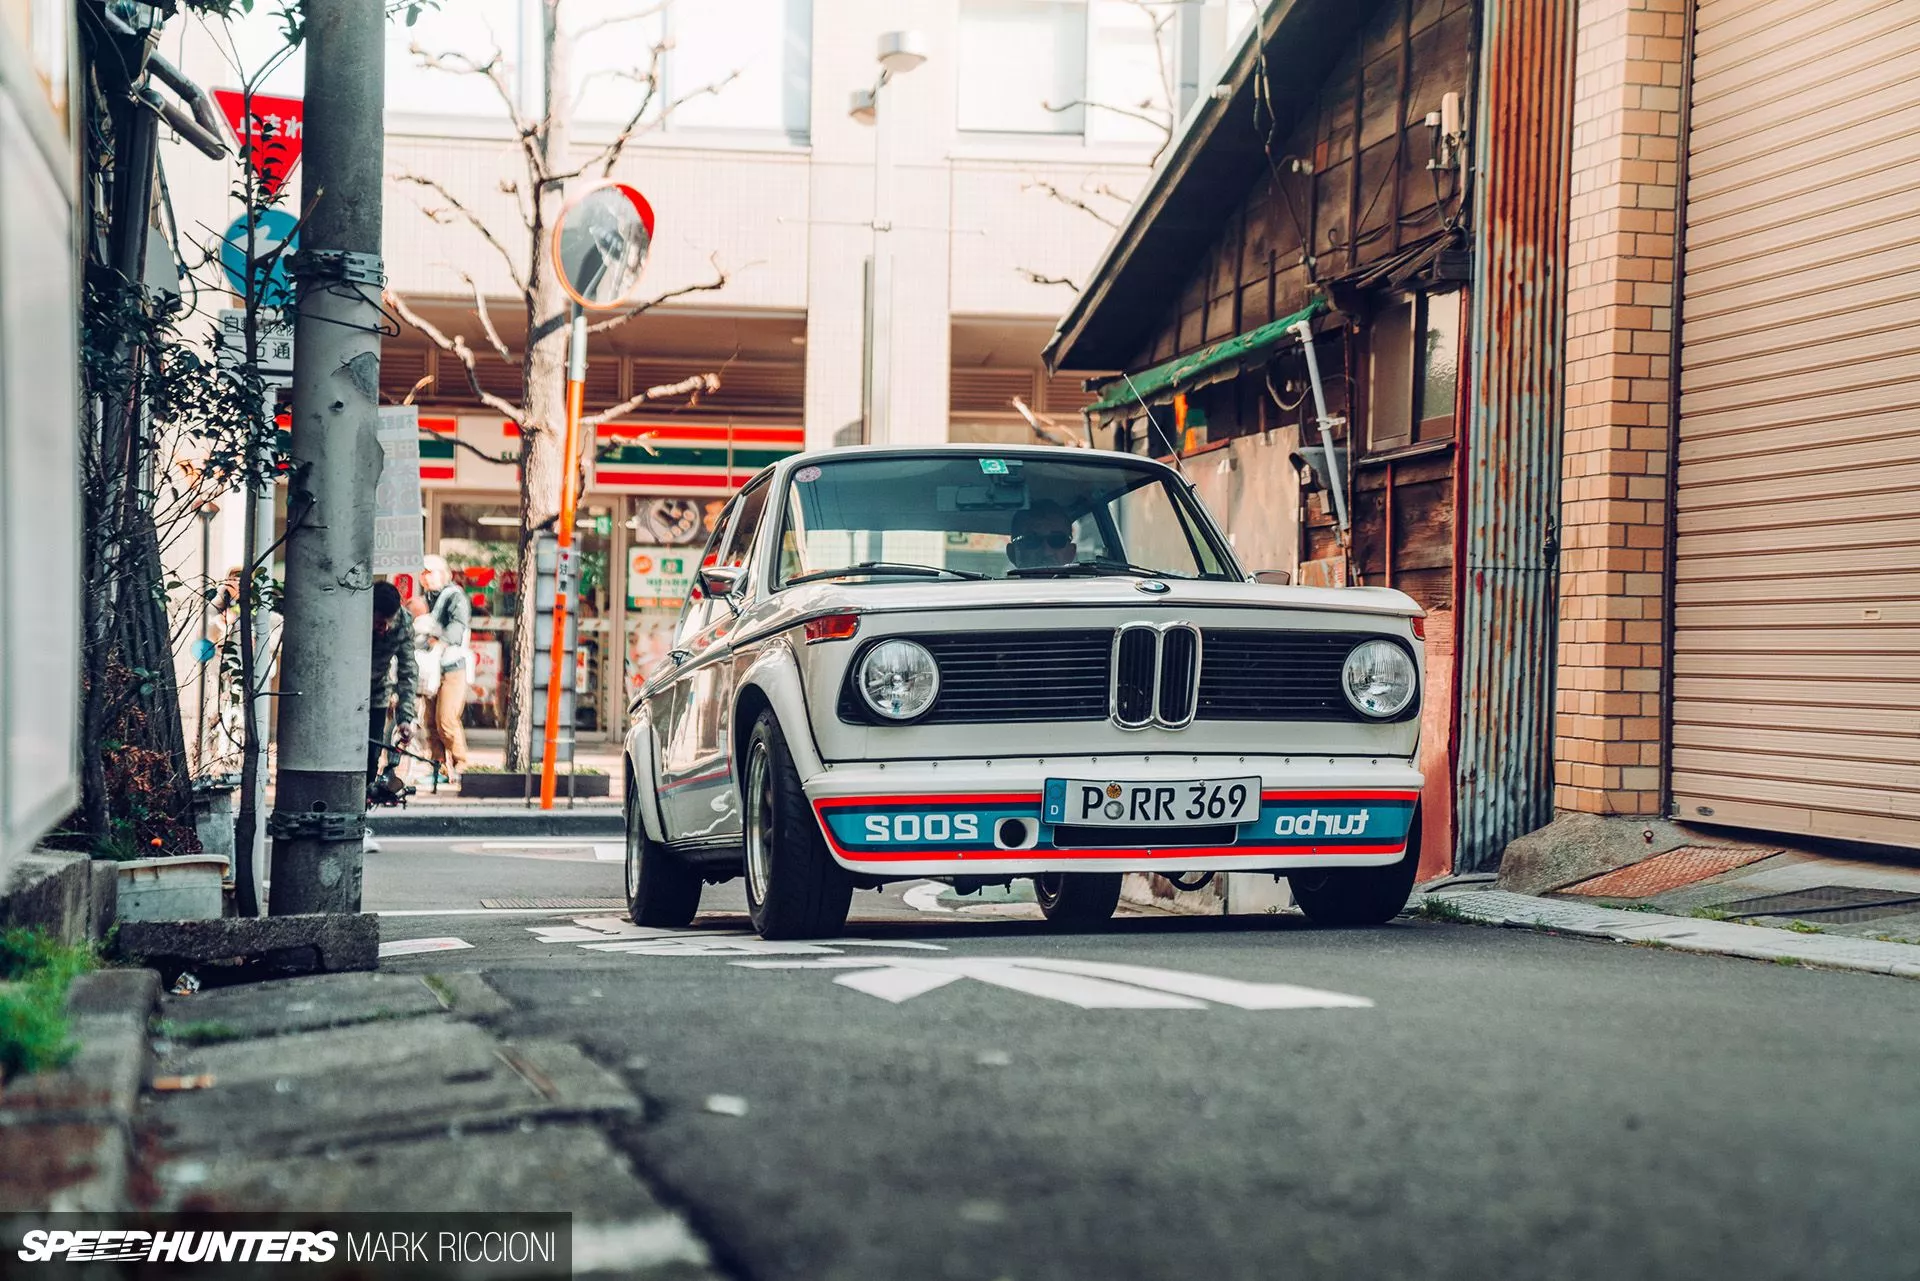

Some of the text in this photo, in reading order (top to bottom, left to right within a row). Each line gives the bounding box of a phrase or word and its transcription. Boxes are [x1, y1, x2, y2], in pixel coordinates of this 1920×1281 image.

[1050, 804, 1059, 816] D
[1081, 784, 1247, 821] P RR 369
